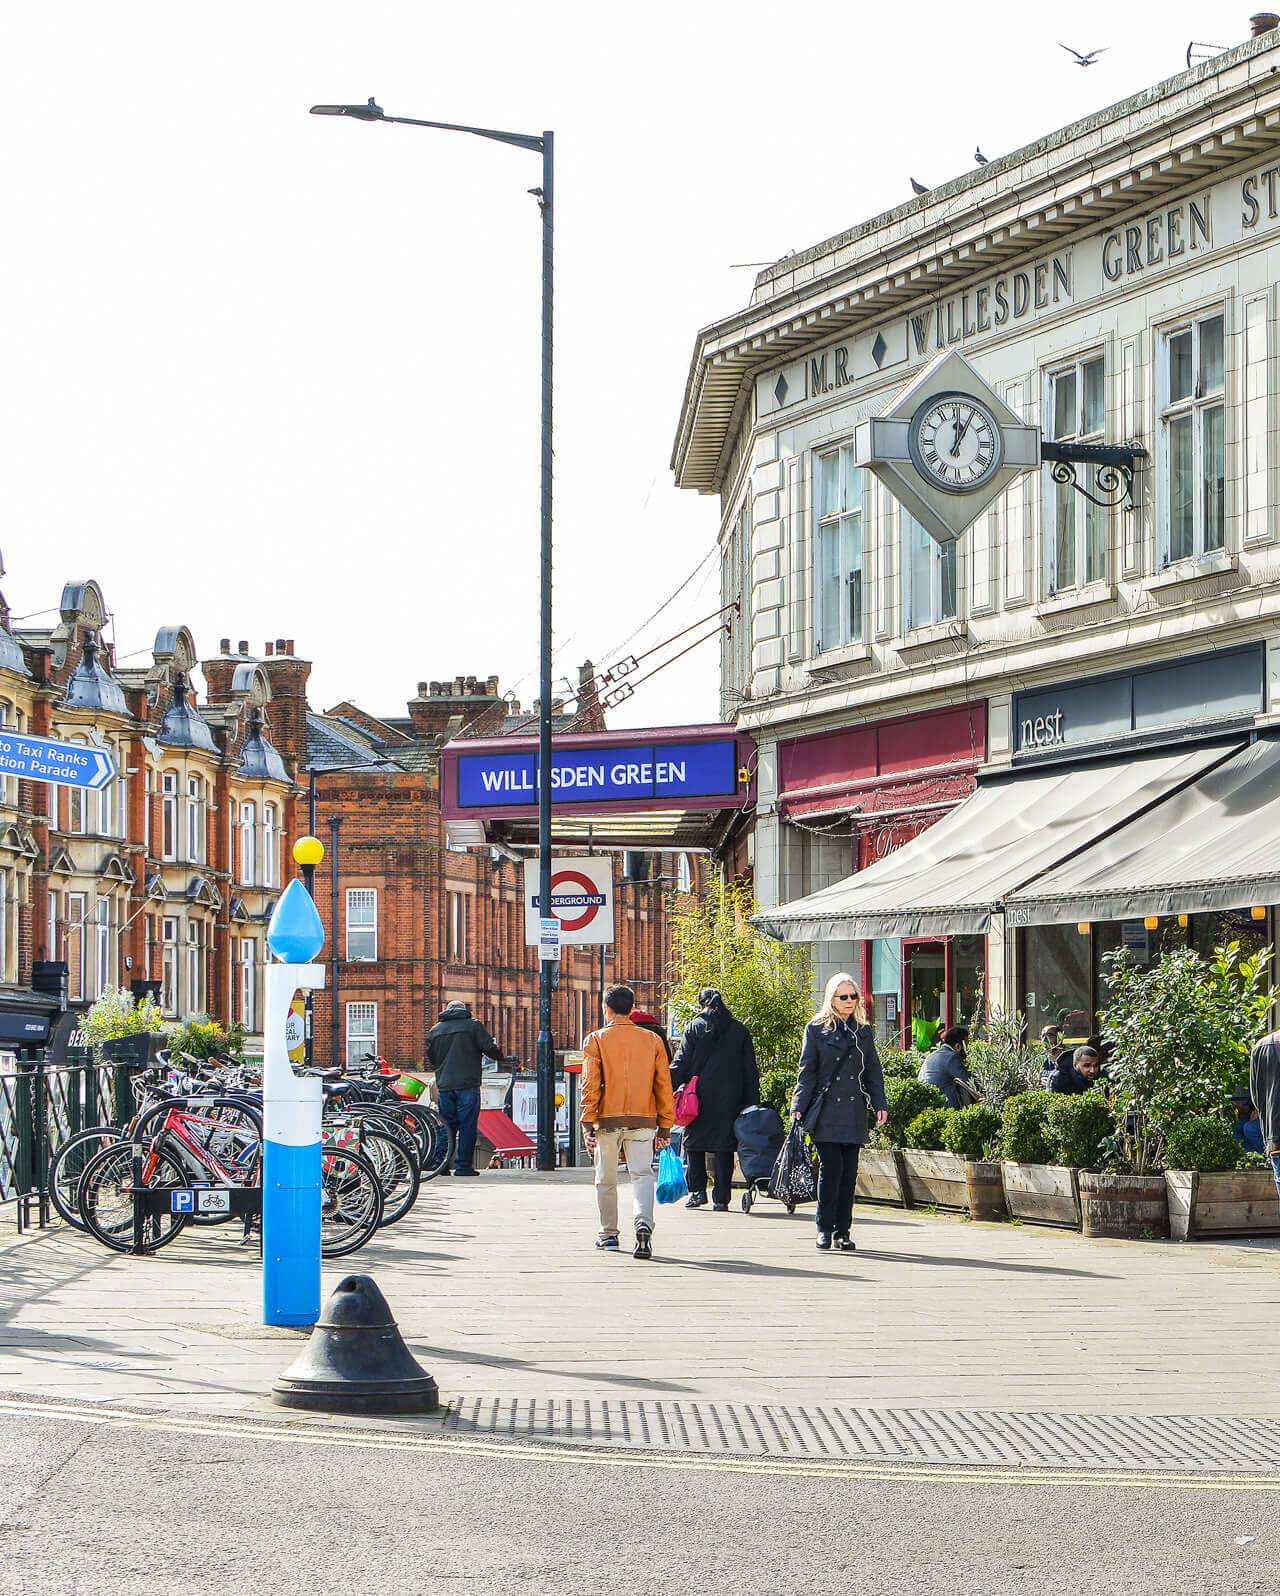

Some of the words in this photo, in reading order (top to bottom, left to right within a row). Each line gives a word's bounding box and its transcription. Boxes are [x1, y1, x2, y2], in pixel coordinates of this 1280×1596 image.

[910, 250, 1073, 353] WILLESDEN
[1102, 195, 1212, 283] GREEN
[809, 345, 855, 398] M.R.
[1021, 707, 1064, 746] nest
[16, 743, 42, 758] Taxi
[48, 748, 88, 766] Ranks
[31, 760, 78, 779] Parade
[481, 765, 604, 792] WILLSDEN
[611, 761, 686, 785] GREEN
[535, 896, 602, 906] UDERGROUND
[1009, 907, 1032, 924] nest
[177, 1193, 190, 1211] P
